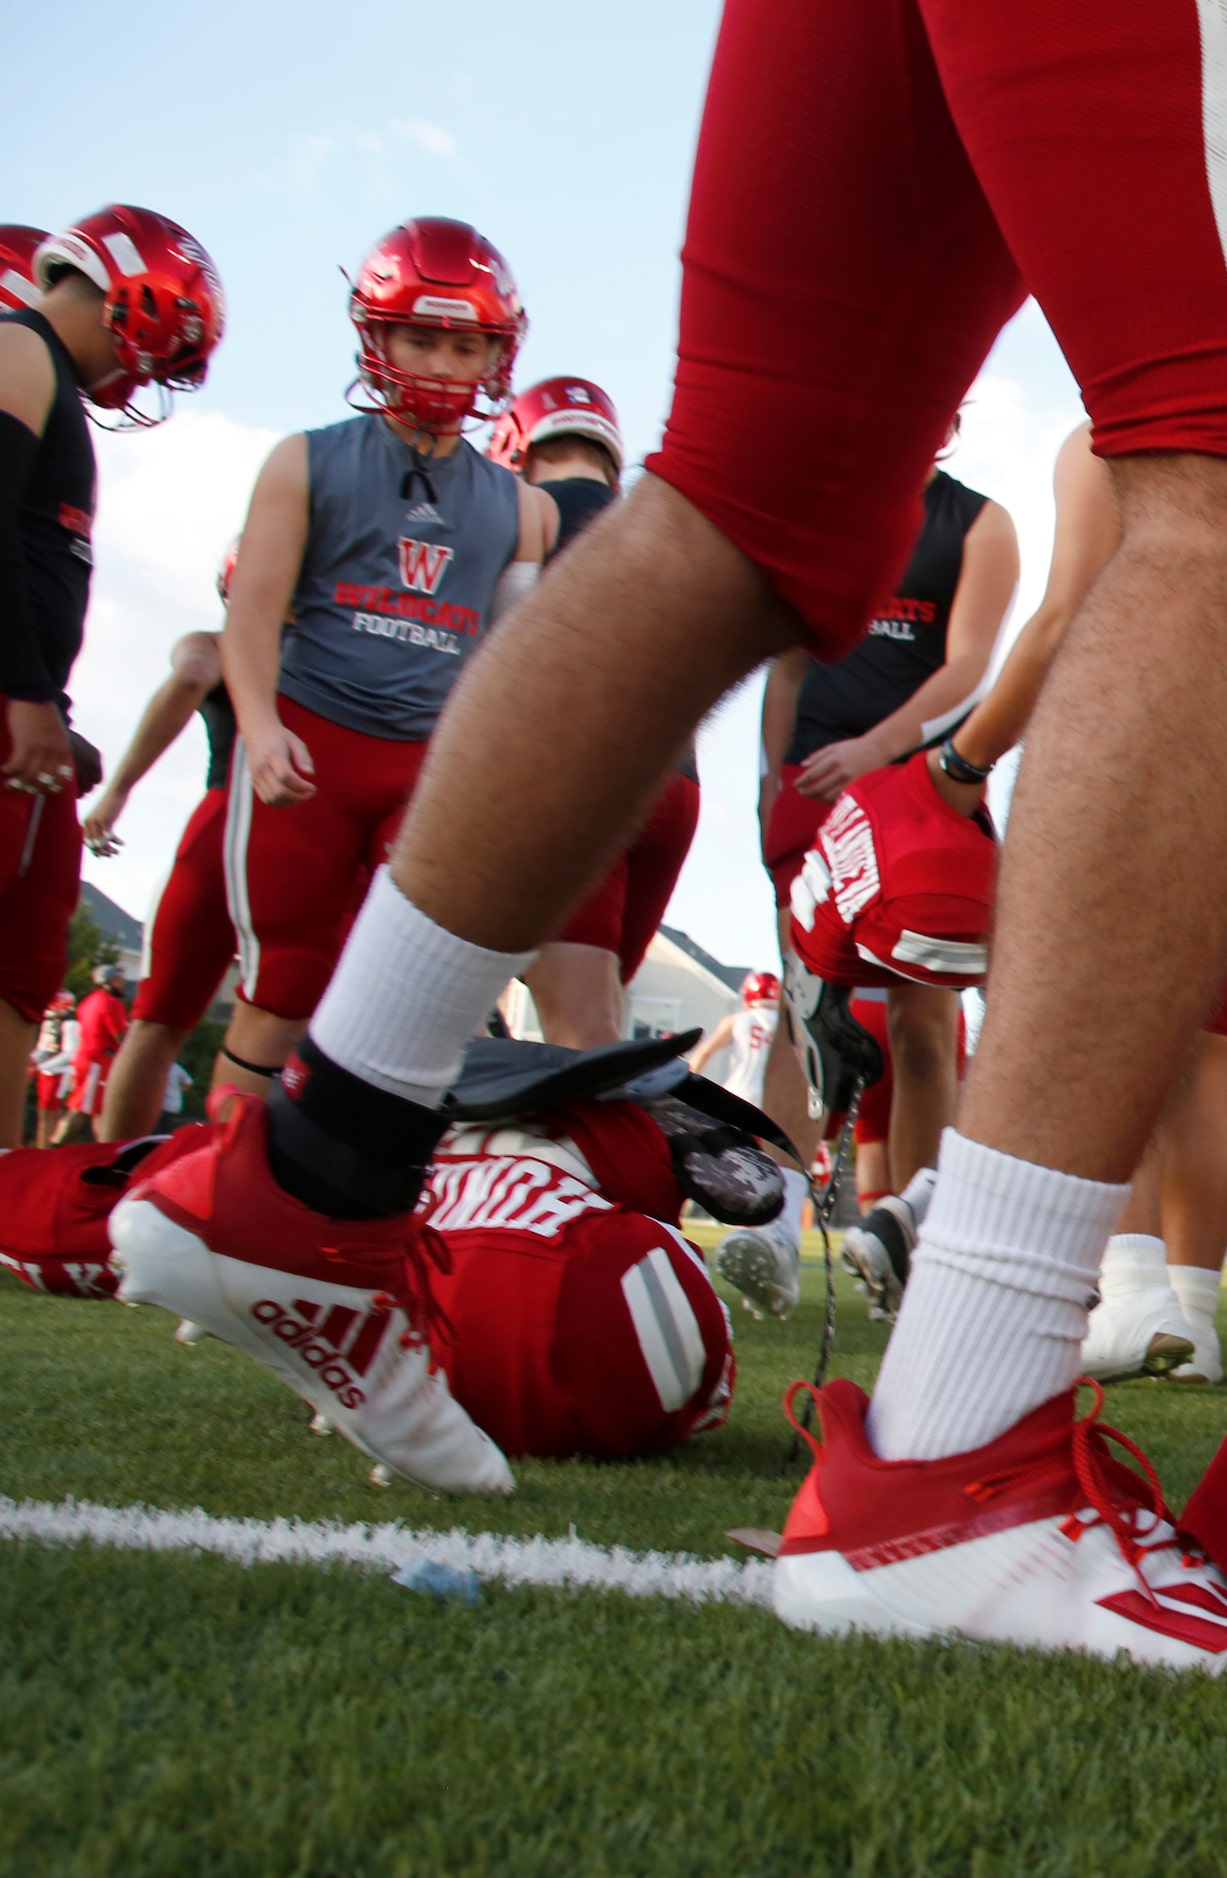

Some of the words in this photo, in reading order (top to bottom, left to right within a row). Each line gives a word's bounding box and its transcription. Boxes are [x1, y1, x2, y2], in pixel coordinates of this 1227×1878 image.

[397, 536, 454, 595] W
[334, 582, 480, 635] WILDCATS
[352, 611, 462, 655] FOOTBALL
[252, 1299, 367, 1410] adidas
